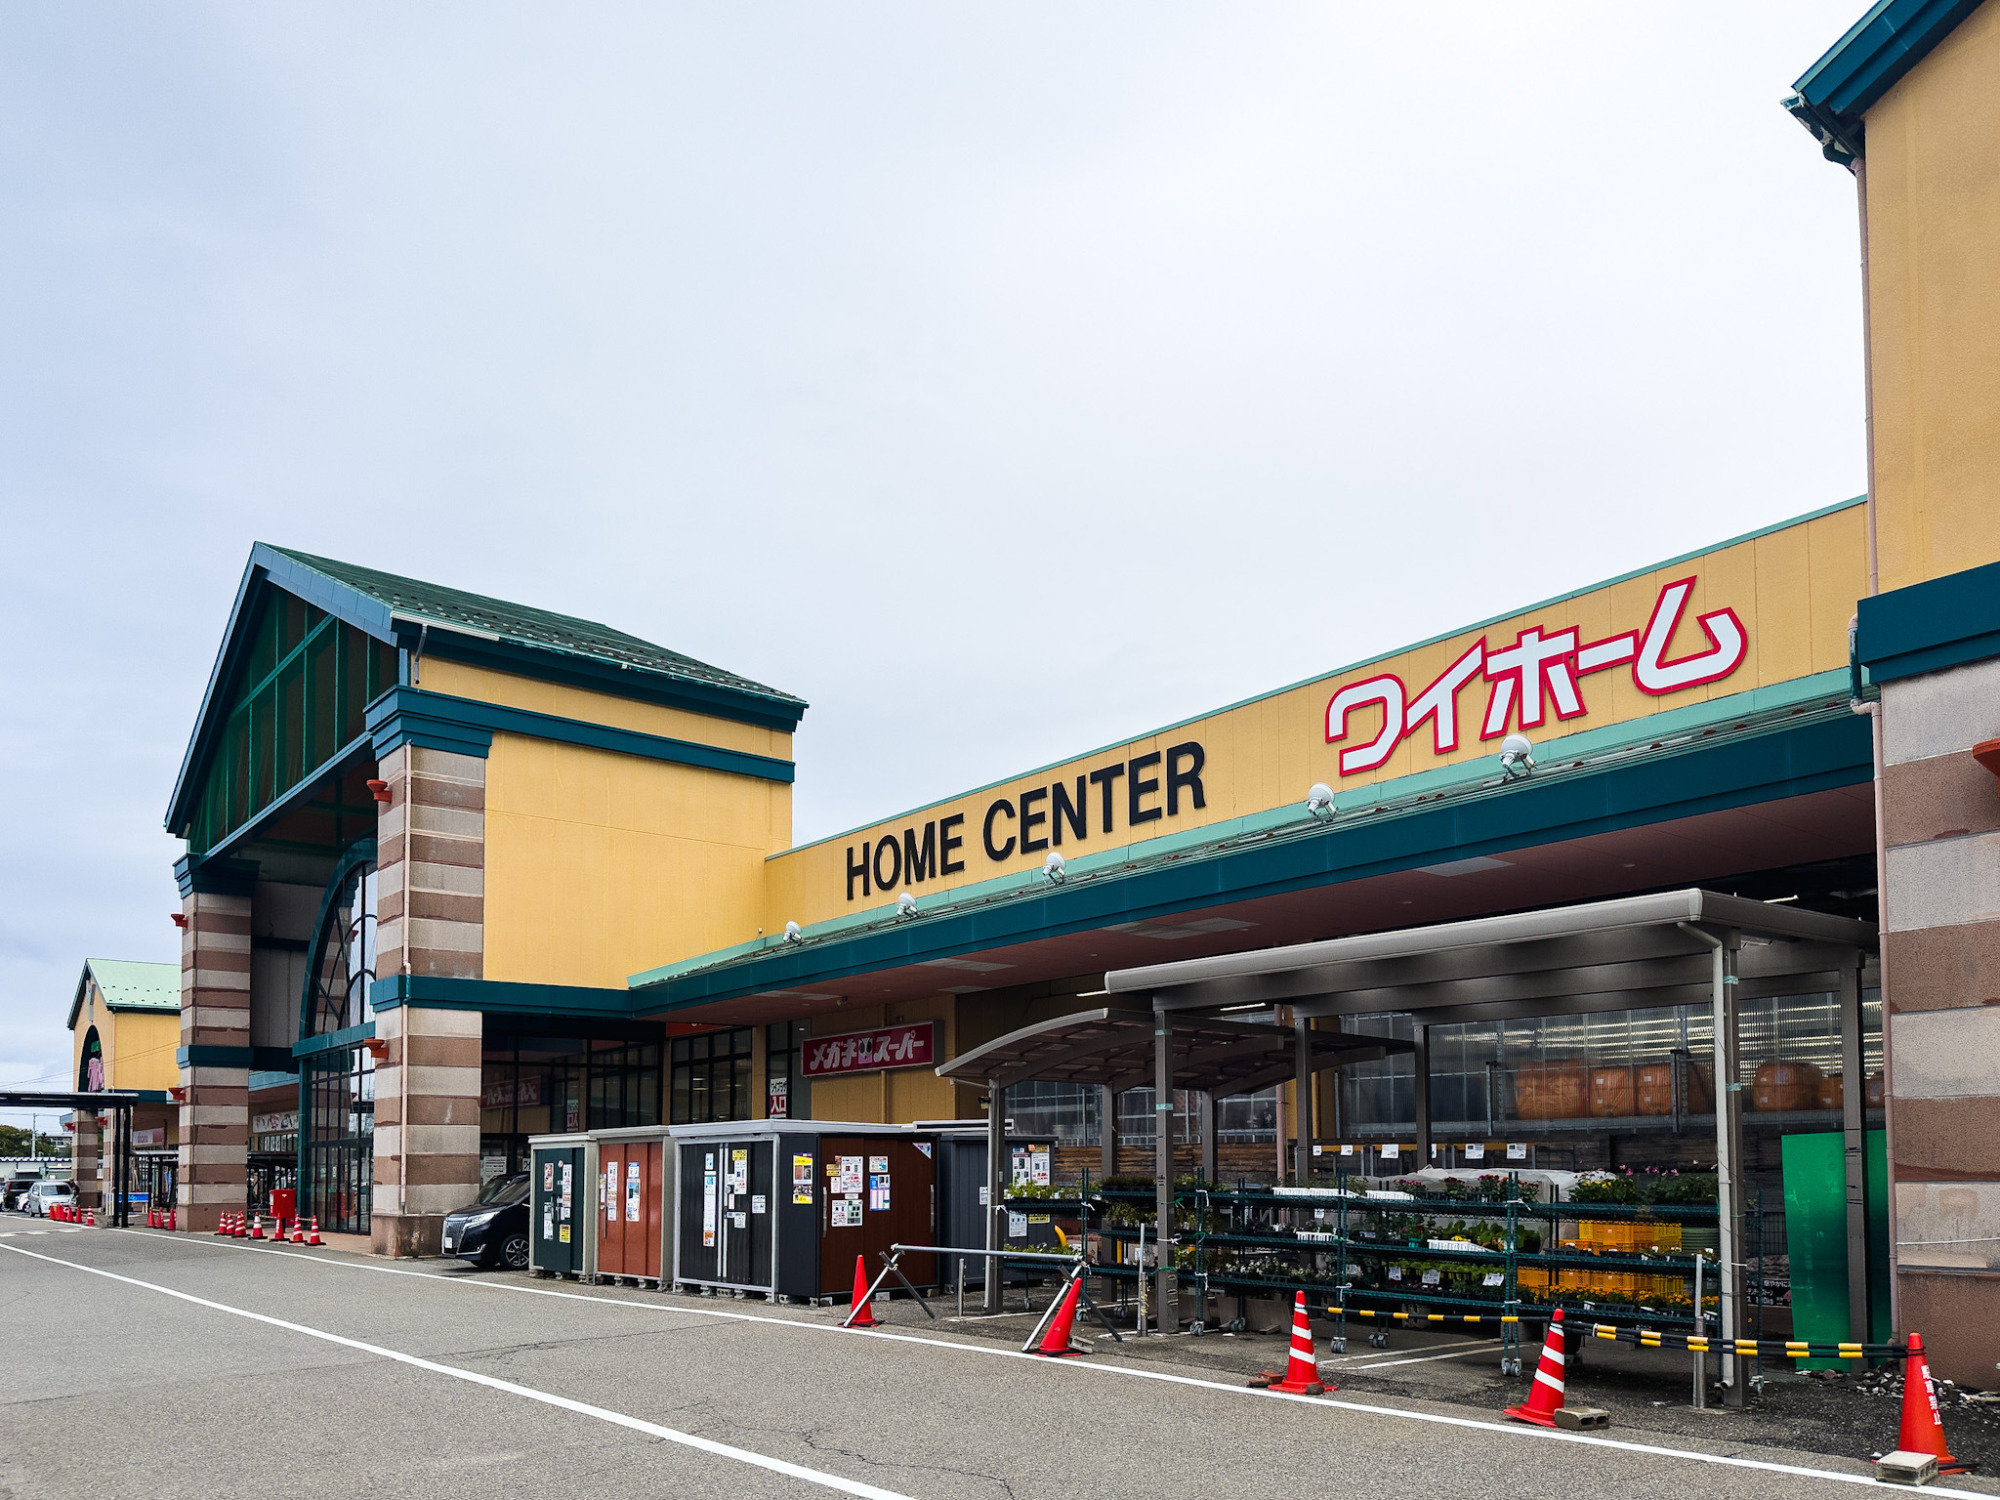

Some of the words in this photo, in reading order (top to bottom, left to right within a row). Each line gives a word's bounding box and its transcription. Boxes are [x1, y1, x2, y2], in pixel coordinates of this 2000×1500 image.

[1325, 574, 1748, 776] ワイホーム
[846, 812, 965, 901] HOME
[983, 741, 1206, 862] CENTER
[810, 1029, 925, 1070] メガネスーパー
[770, 1096, 787, 1113] 入口
